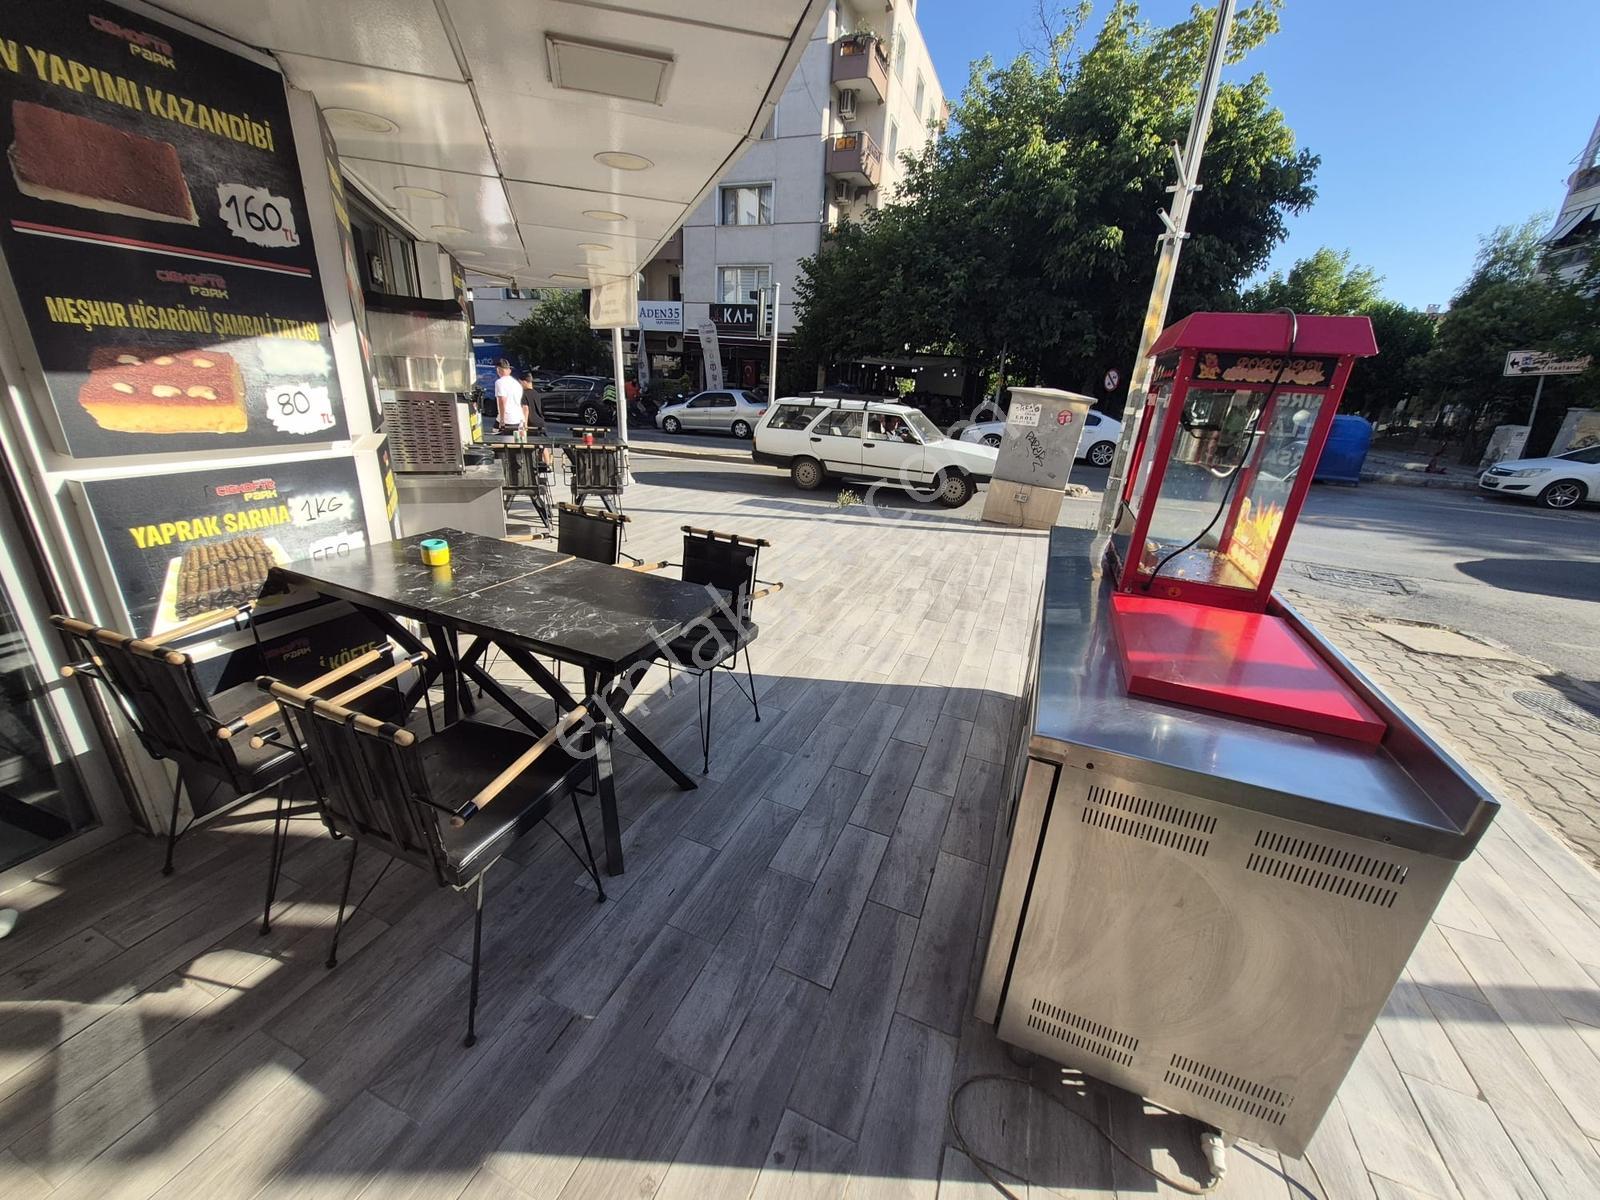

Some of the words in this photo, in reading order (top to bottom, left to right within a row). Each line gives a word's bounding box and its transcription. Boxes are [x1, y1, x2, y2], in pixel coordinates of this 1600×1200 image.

[24, 44, 142, 111] YAPIMI
[145, 85, 275, 152] KAZANDİBİ
[226, 195, 282, 232] 160
[45, 296, 129, 332] MEŞHUR
[130, 300, 213, 334] HİSARÖNÜ
[277, 391, 310, 416] 80
[129, 514, 221, 549] YAPRAK
[223, 505, 291, 532] SARMA
